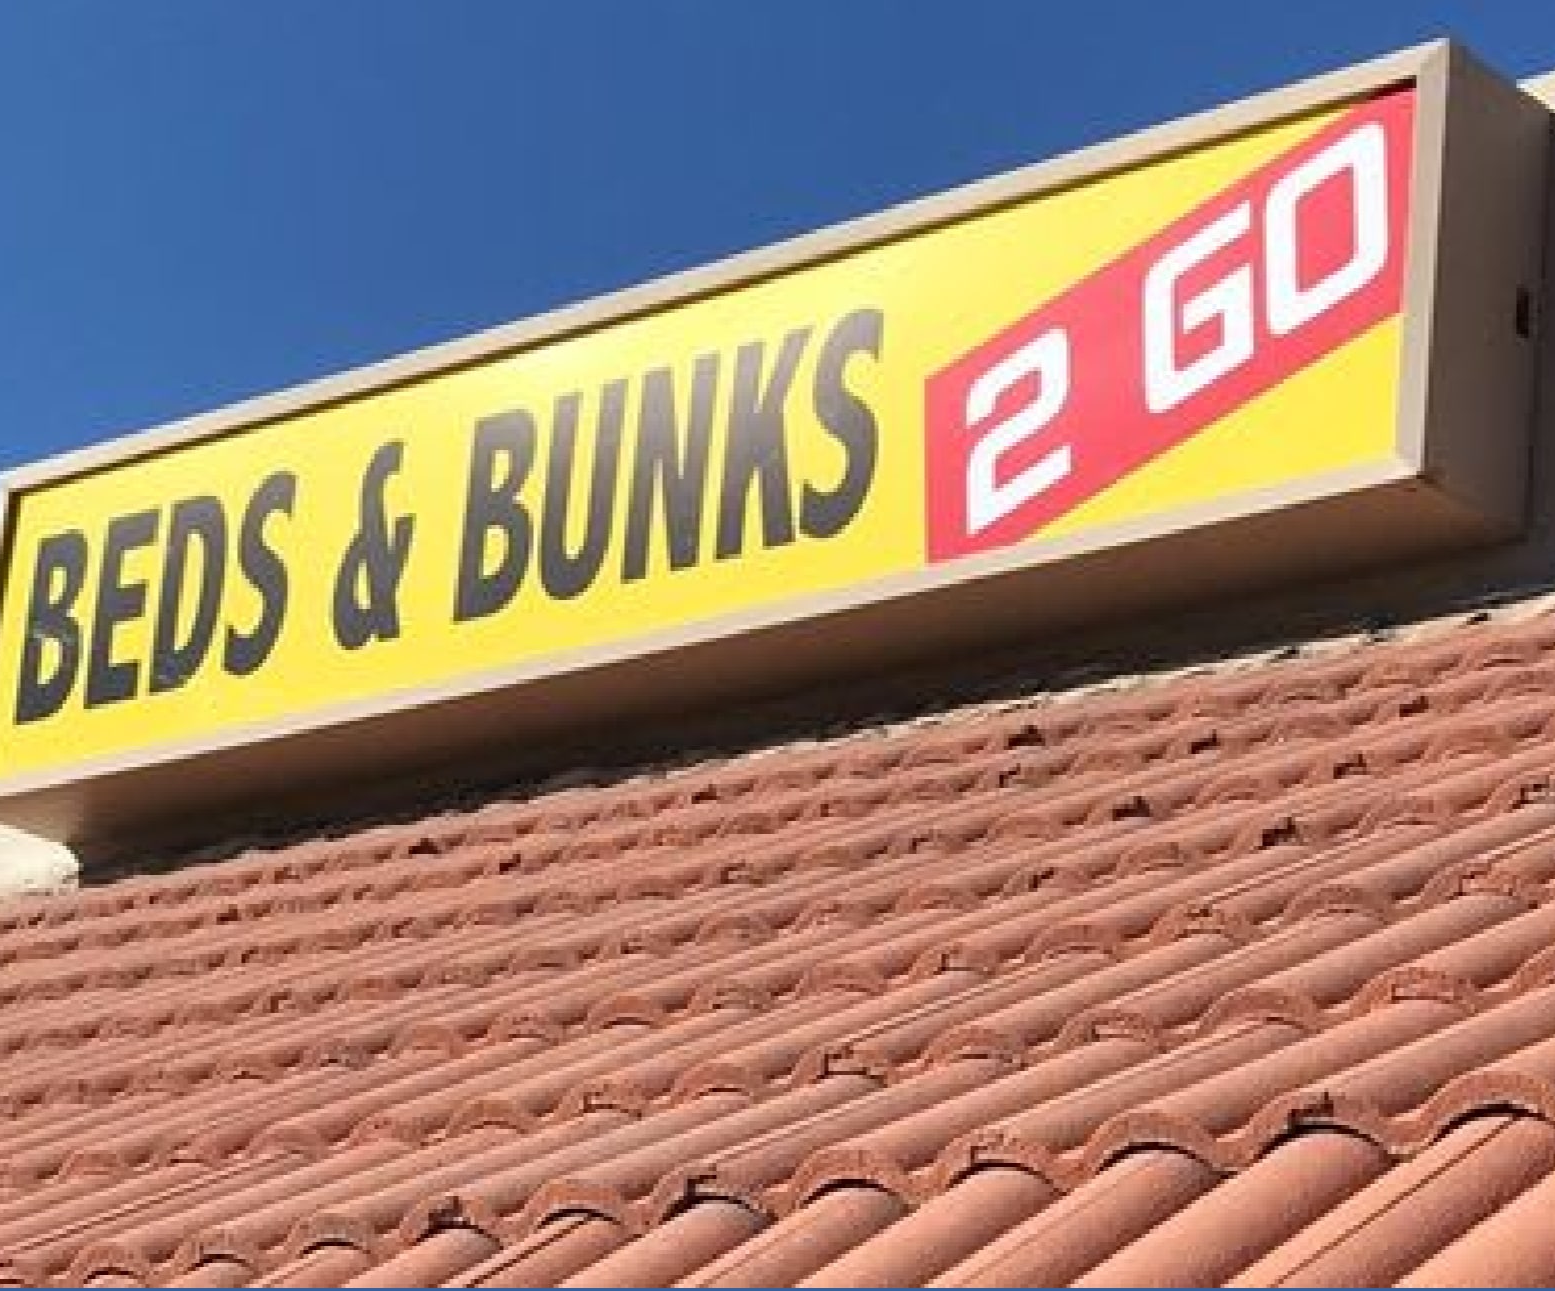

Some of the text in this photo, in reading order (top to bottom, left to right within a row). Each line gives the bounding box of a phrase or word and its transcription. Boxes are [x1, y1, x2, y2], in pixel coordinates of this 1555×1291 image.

[14, 121, 1389, 725] BEDS & BUNKS 2 GO
